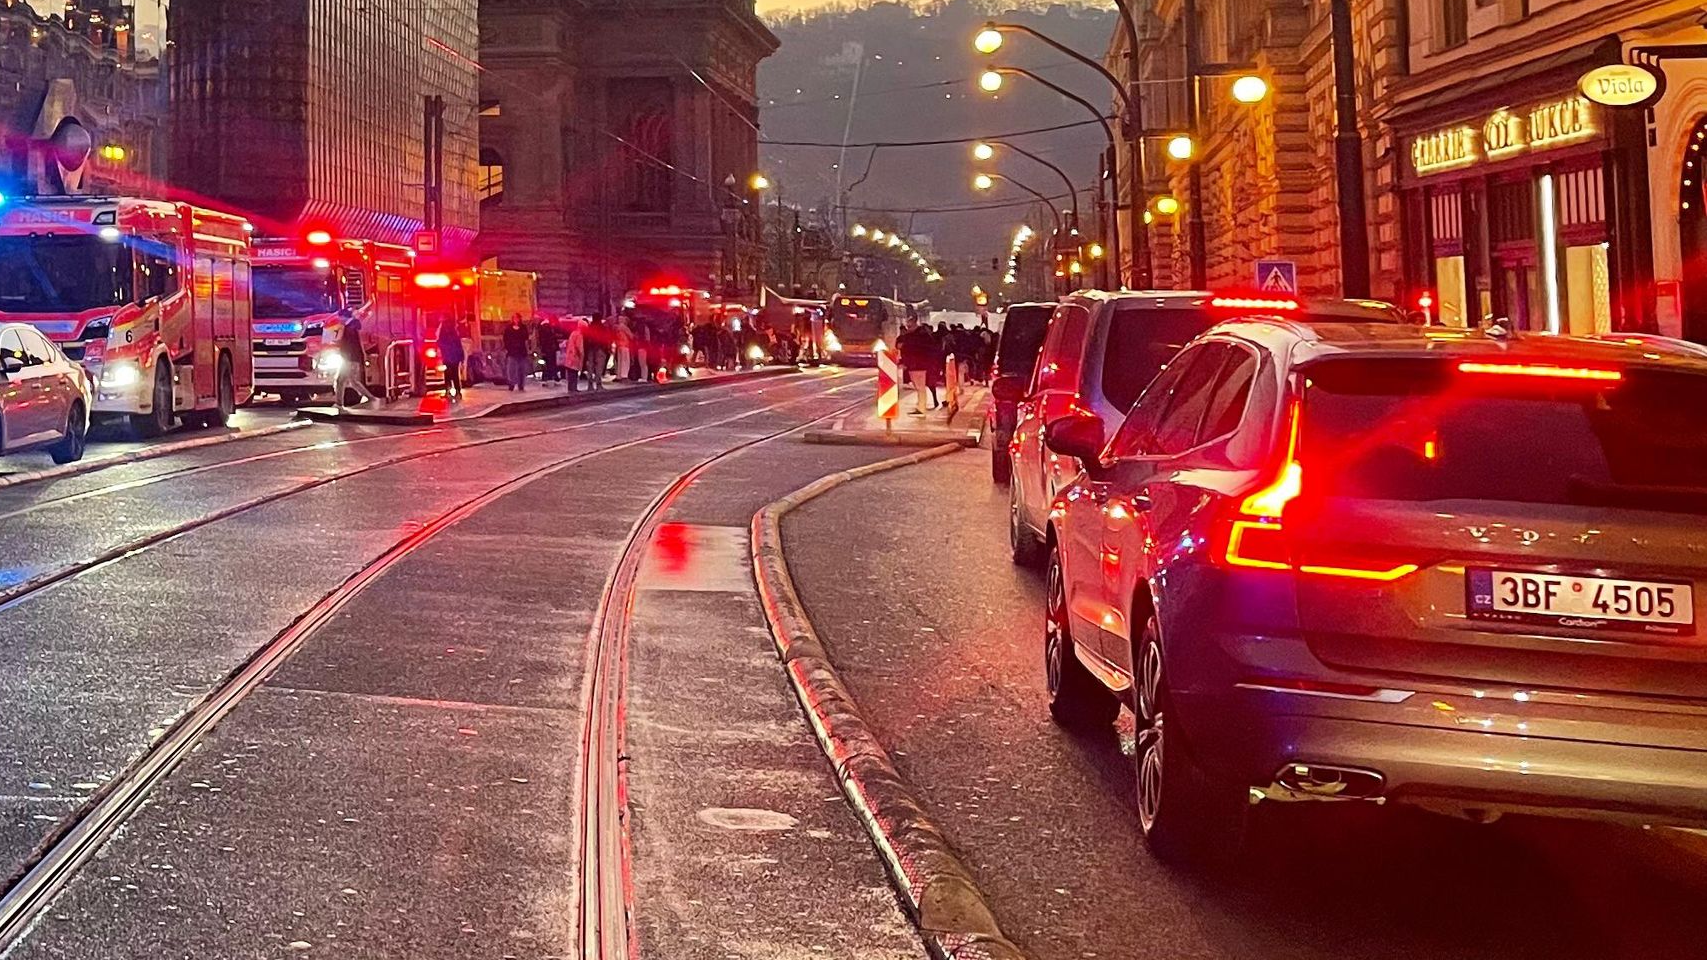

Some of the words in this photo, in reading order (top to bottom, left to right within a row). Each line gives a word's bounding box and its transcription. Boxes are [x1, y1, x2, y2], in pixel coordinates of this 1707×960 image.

[1597, 77, 1644, 95] Viola
[1527, 99, 1582, 143] UKCE
[125, 330, 133, 343] 6
[1475, 594, 1492, 604] CZ
[1500, 576, 1562, 610] 3BF
[1592, 583, 1675, 618] 4505
